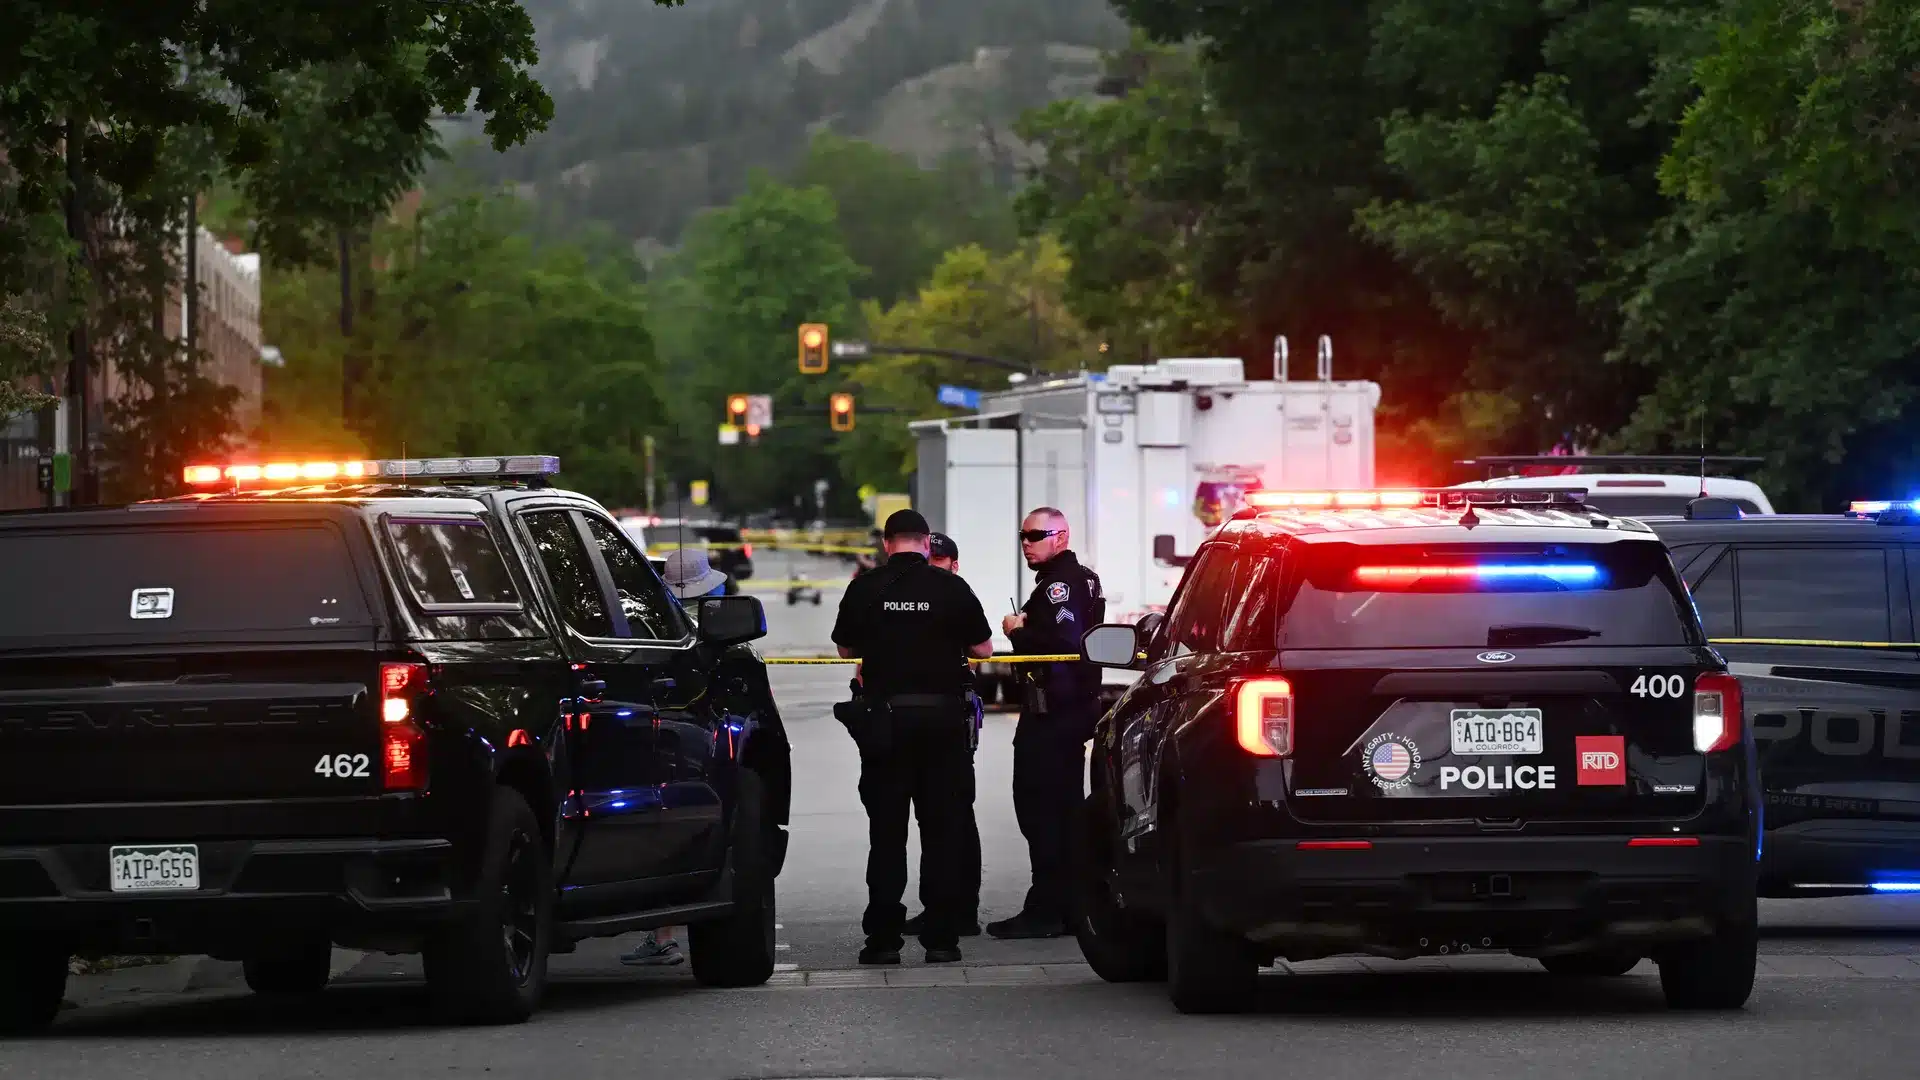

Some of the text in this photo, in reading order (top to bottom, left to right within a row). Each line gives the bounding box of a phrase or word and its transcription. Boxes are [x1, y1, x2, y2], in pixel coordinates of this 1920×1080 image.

[884, 602, 930, 611] POLICE K9
[1486, 652, 1507, 660] Ford
[1630, 674, 1685, 698] 400
[1363, 733, 1393, 771] INTEGRITY
[1402, 736, 1421, 769] HONOR
[1582, 752, 1619, 769] RTD
[314, 753, 370, 778] 462
[1371, 775, 1412, 790] RESPECT
[1440, 766, 1556, 790] POLICE
